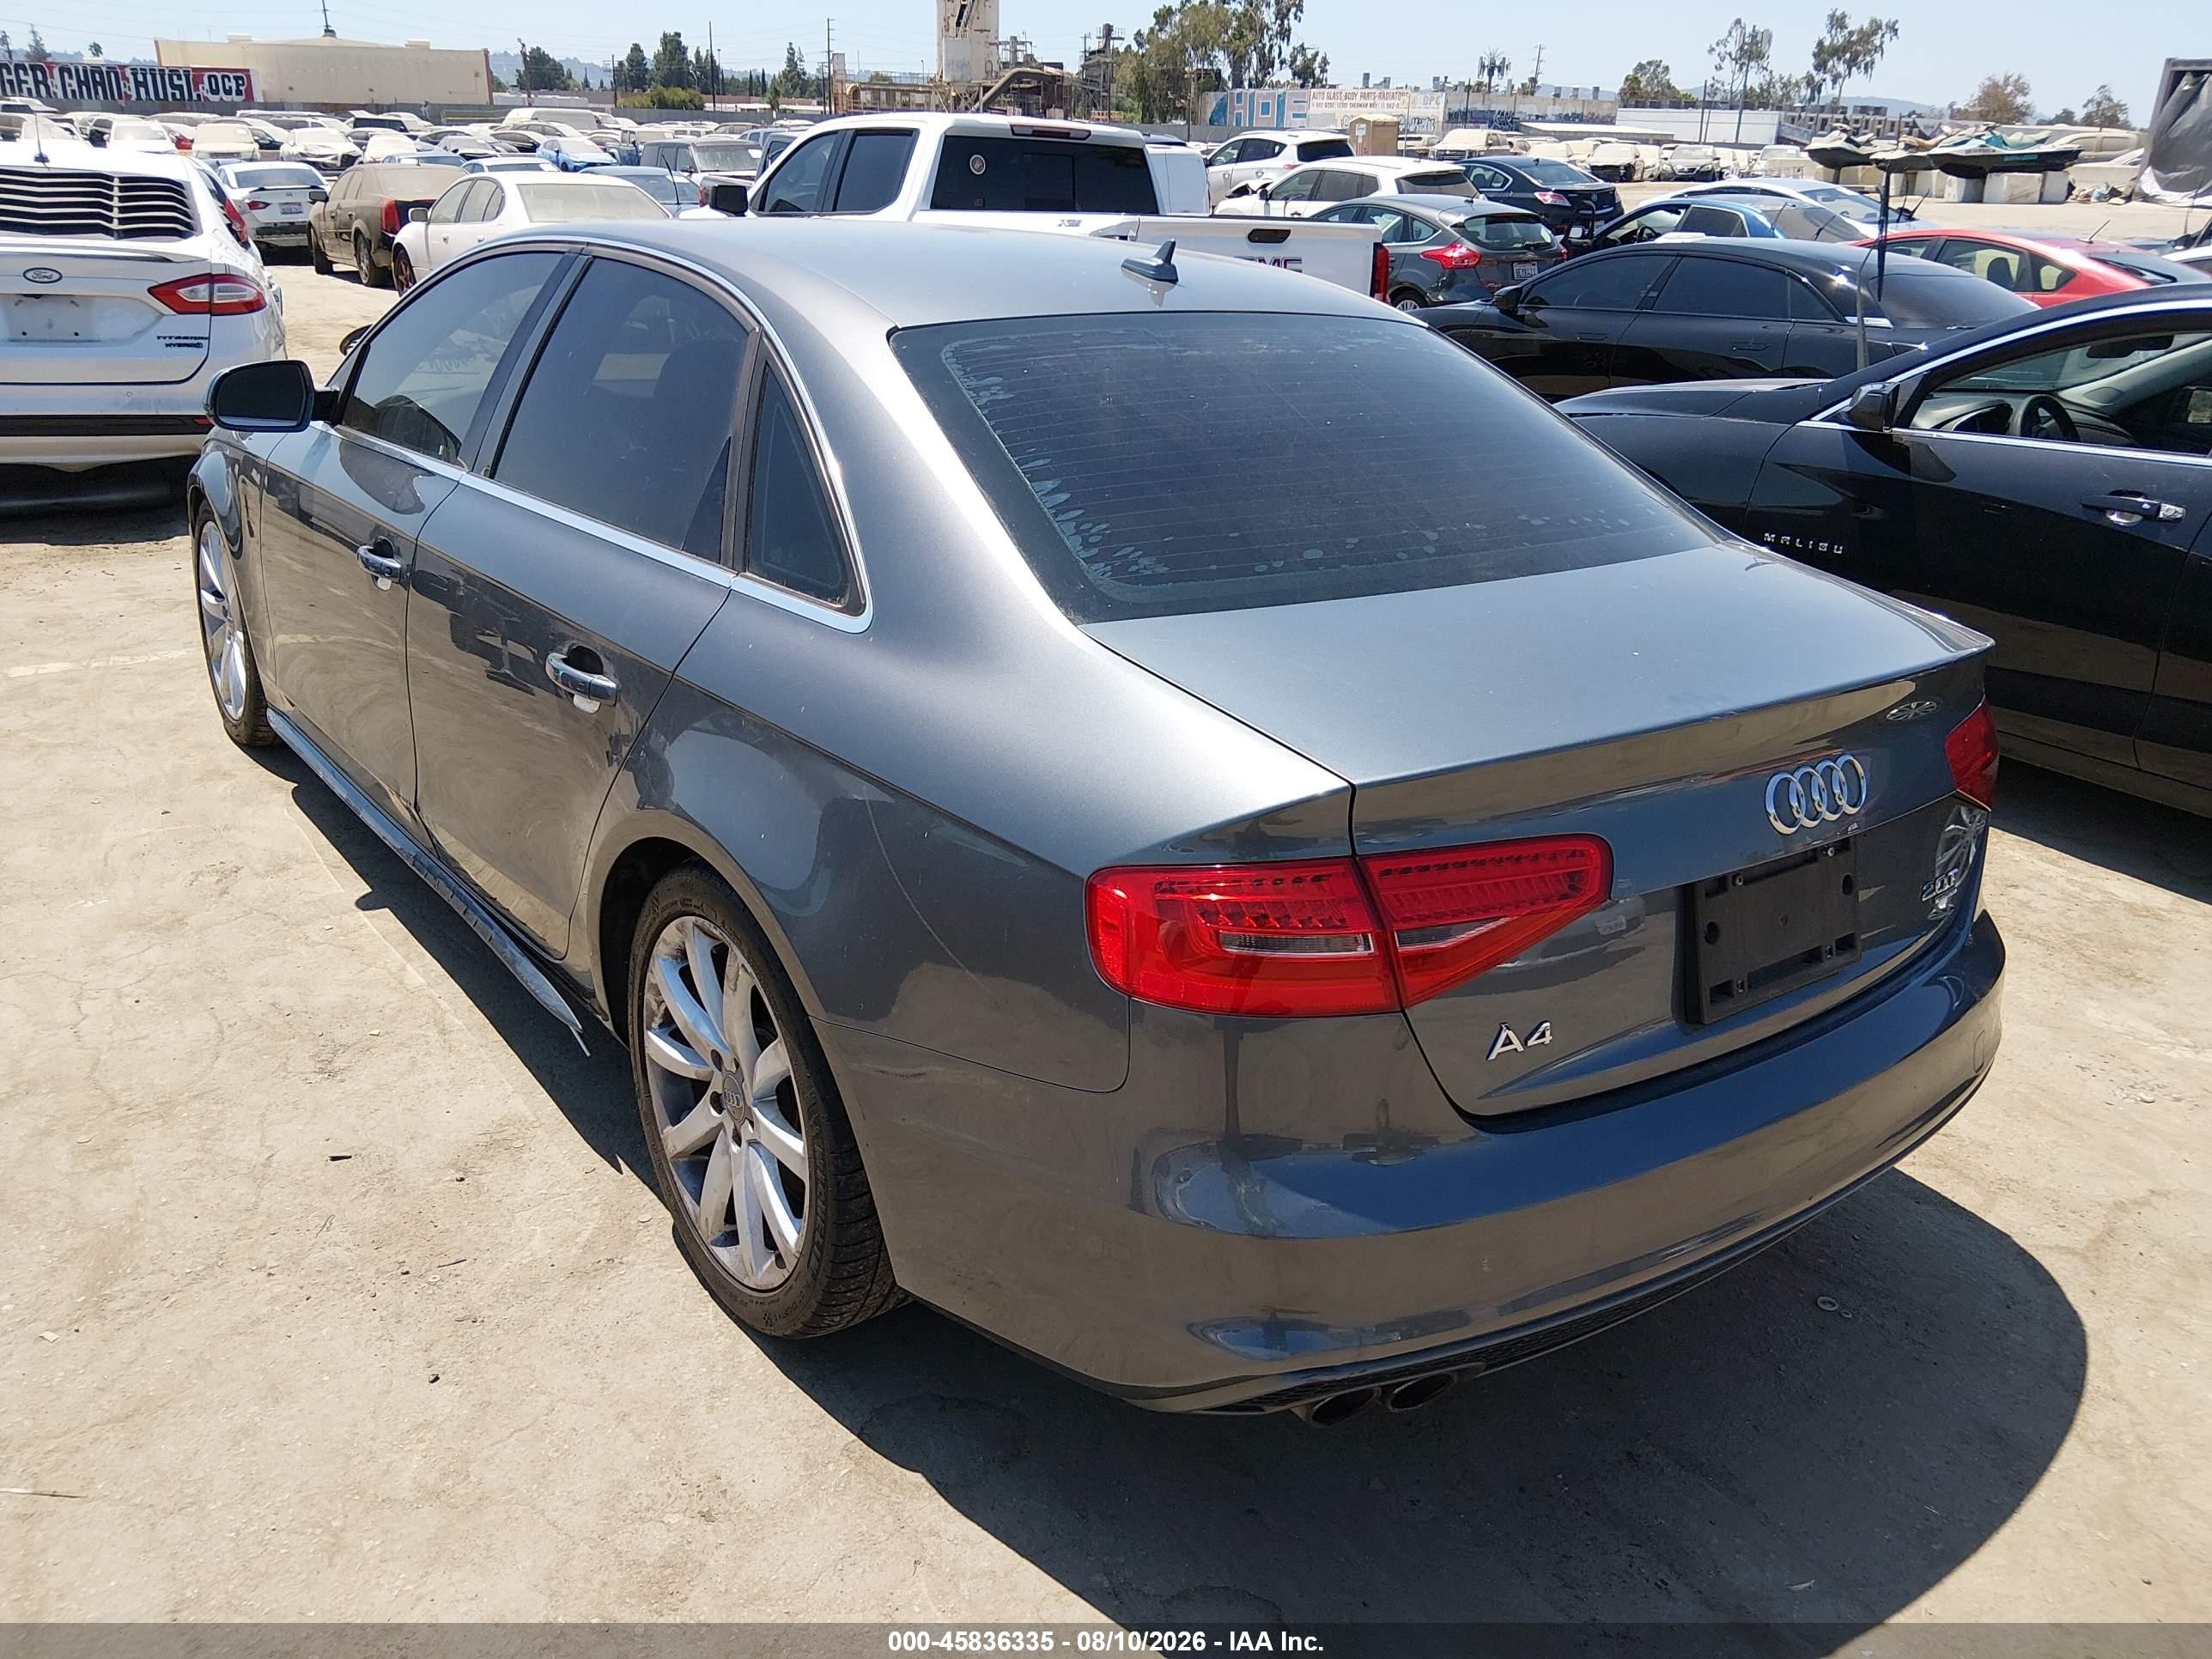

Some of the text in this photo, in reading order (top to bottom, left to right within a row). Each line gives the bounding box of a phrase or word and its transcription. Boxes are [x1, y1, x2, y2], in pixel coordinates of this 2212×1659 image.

[208, 74, 246, 96] OCP
[1312, 92, 1325, 100] AUTO
[1327, 92, 1342, 100] GLASS
[1345, 92, 1358, 100] BODY
[1235, 257, 1303, 273] MC
[1764, 532, 1843, 554] MALIBU
[1485, 1019, 1553, 1061] A4
